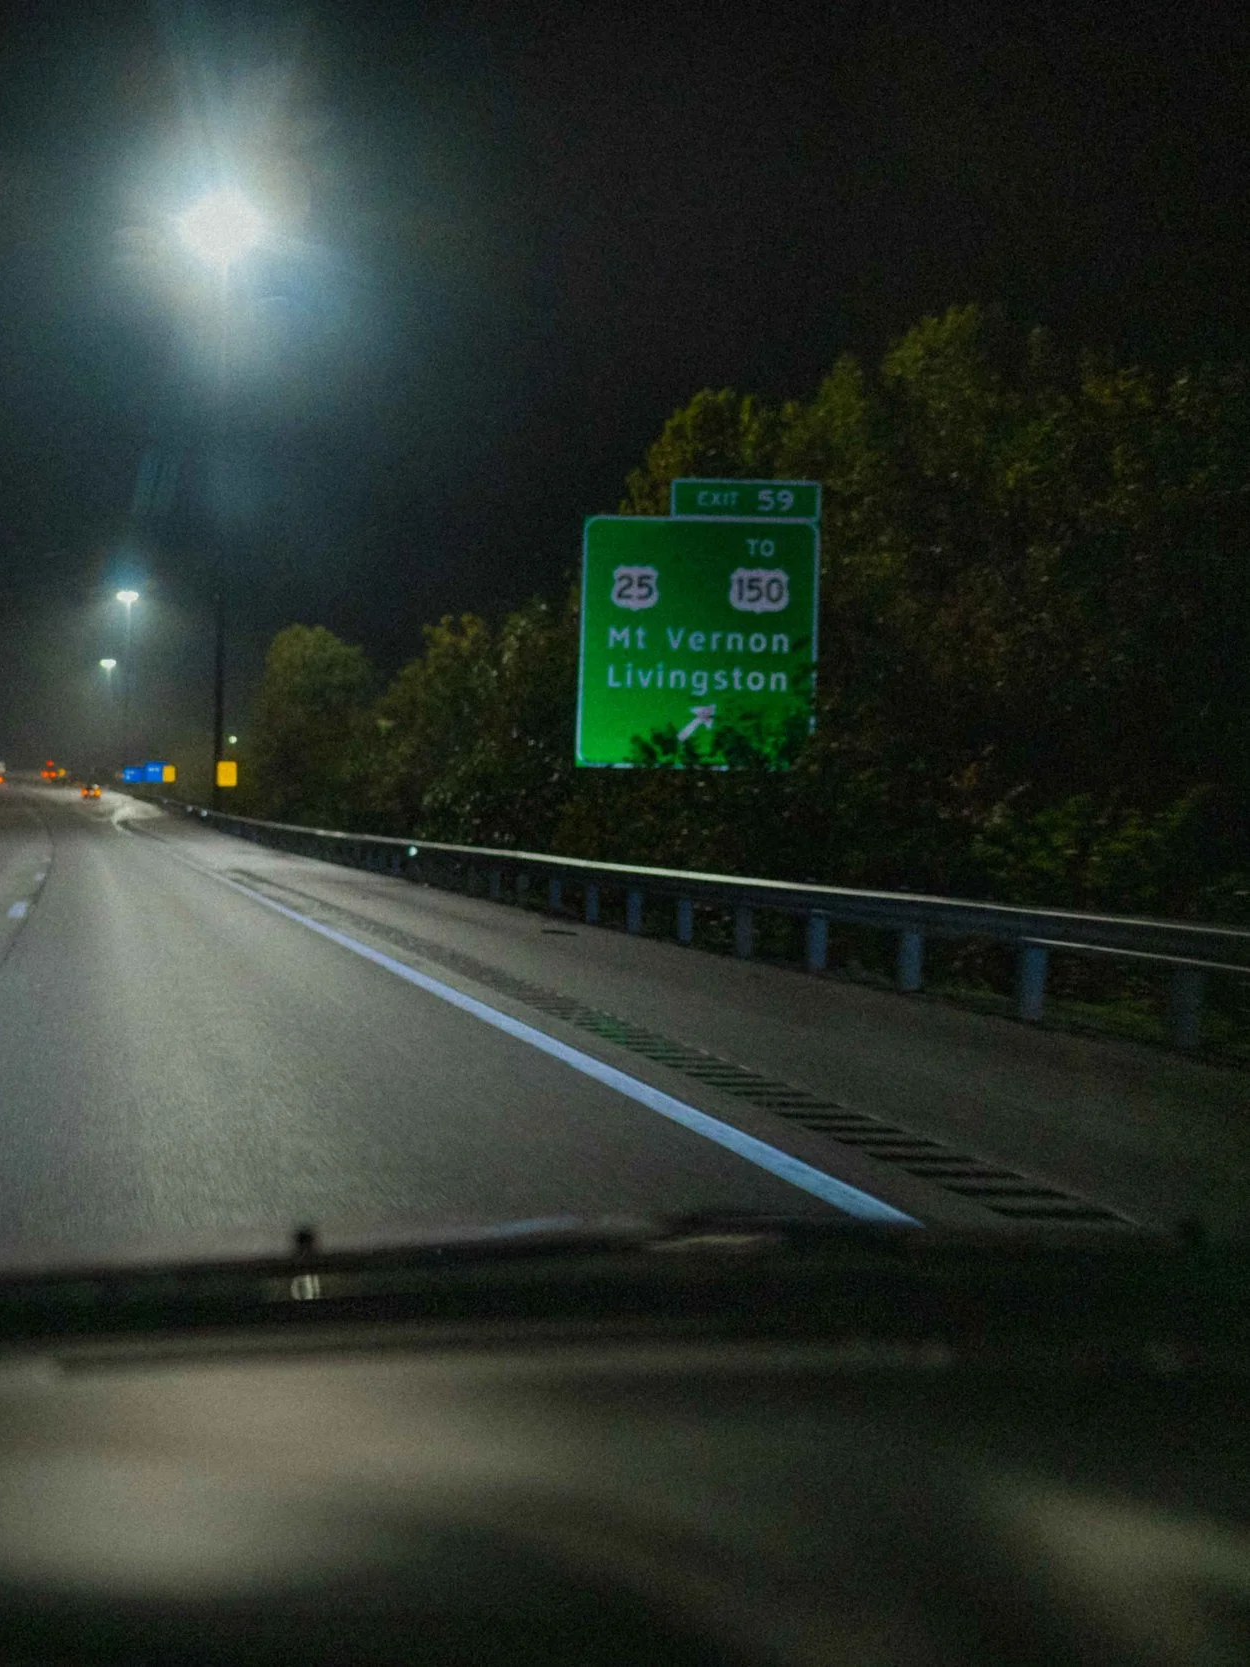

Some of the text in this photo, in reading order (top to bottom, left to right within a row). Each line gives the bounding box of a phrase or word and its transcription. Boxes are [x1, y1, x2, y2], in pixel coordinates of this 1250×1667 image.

[696, 489, 795, 512] EXIT 59
[747, 539, 775, 557] TO
[616, 574, 655, 601] 25
[736, 578, 785, 604] 150
[608, 627, 790, 654] Mt Vernon
[607, 663, 788, 696] Livingston
